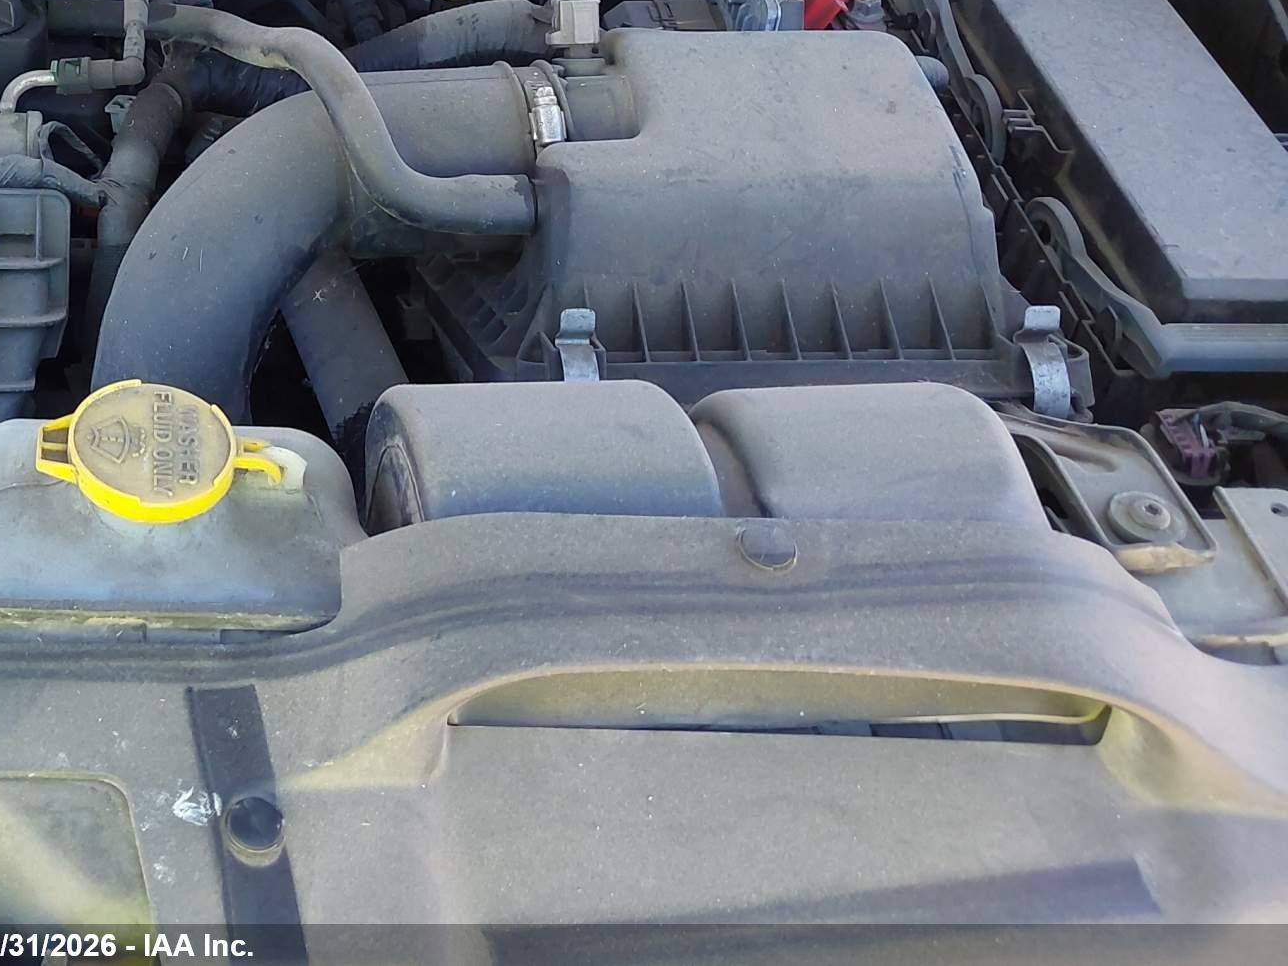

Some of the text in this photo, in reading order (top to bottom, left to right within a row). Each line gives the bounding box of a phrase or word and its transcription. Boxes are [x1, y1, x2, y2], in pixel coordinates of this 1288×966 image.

[153, 392, 173, 497] FLUID ONLY
[179, 405, 201, 485] WASHER
